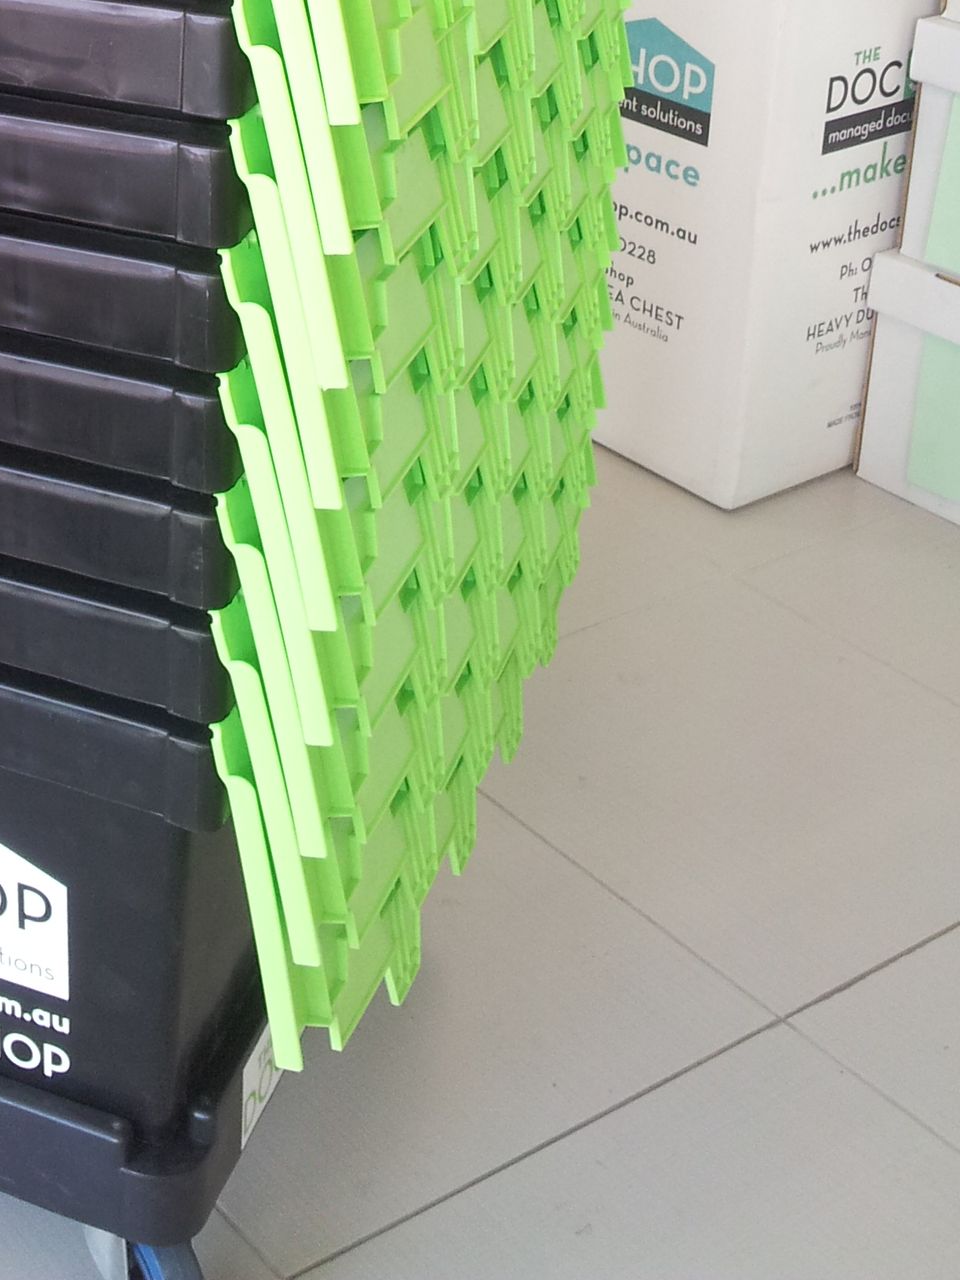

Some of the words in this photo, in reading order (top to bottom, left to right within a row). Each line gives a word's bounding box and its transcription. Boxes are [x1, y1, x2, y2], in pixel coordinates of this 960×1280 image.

[854, 46, 881, 66] THE
[632, 48, 707, 100] HOP
[825, 60, 903, 114] DOC
[641, 101, 703, 135] solutions
[828, 110, 885, 144] managed
[624, 144, 700, 186] pace
[853, 285, 868, 303] Th
[624, 312, 668, 342] Australia
[630, 295, 684, 331] CHEST
[806, 312, 853, 341] HEAVY
[856, 308, 874, 324] DU
